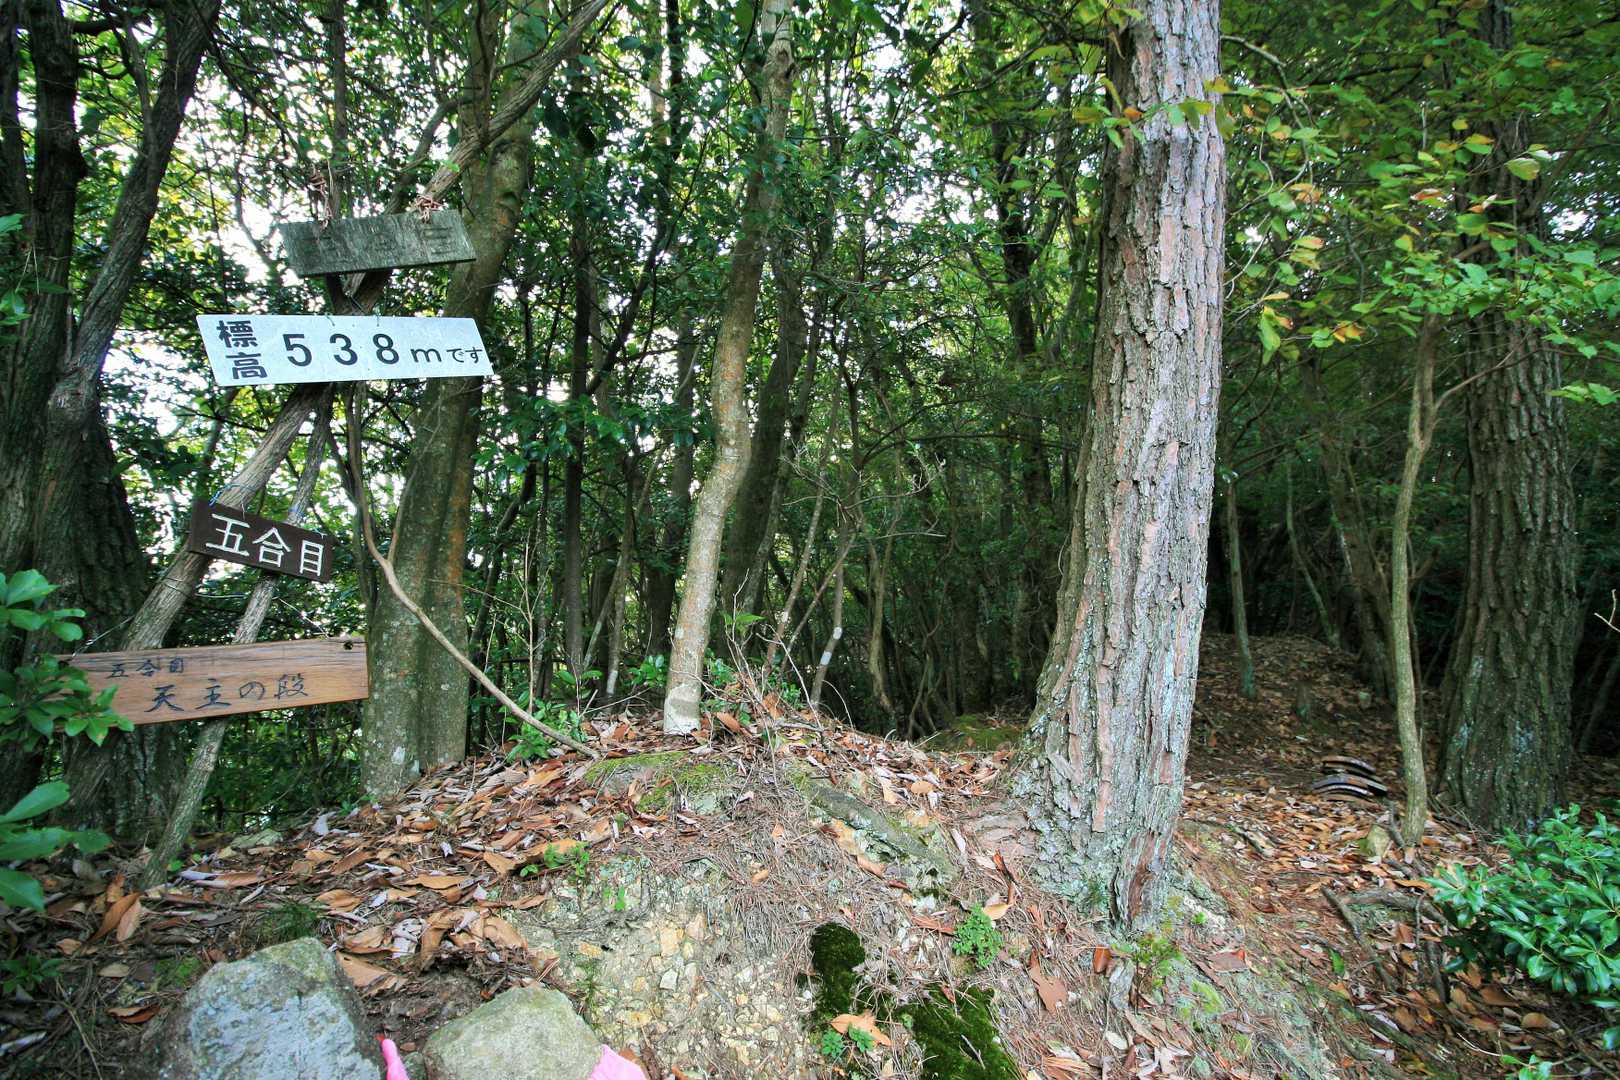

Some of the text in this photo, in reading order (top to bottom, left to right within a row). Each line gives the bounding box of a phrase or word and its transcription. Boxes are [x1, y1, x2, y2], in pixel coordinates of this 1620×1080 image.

[216, 319, 268, 380] 標高
[205, 513, 324, 577] 五合目
[106, 656, 186, 680] 五合目
[143, 673, 309, 713] 天主の段
